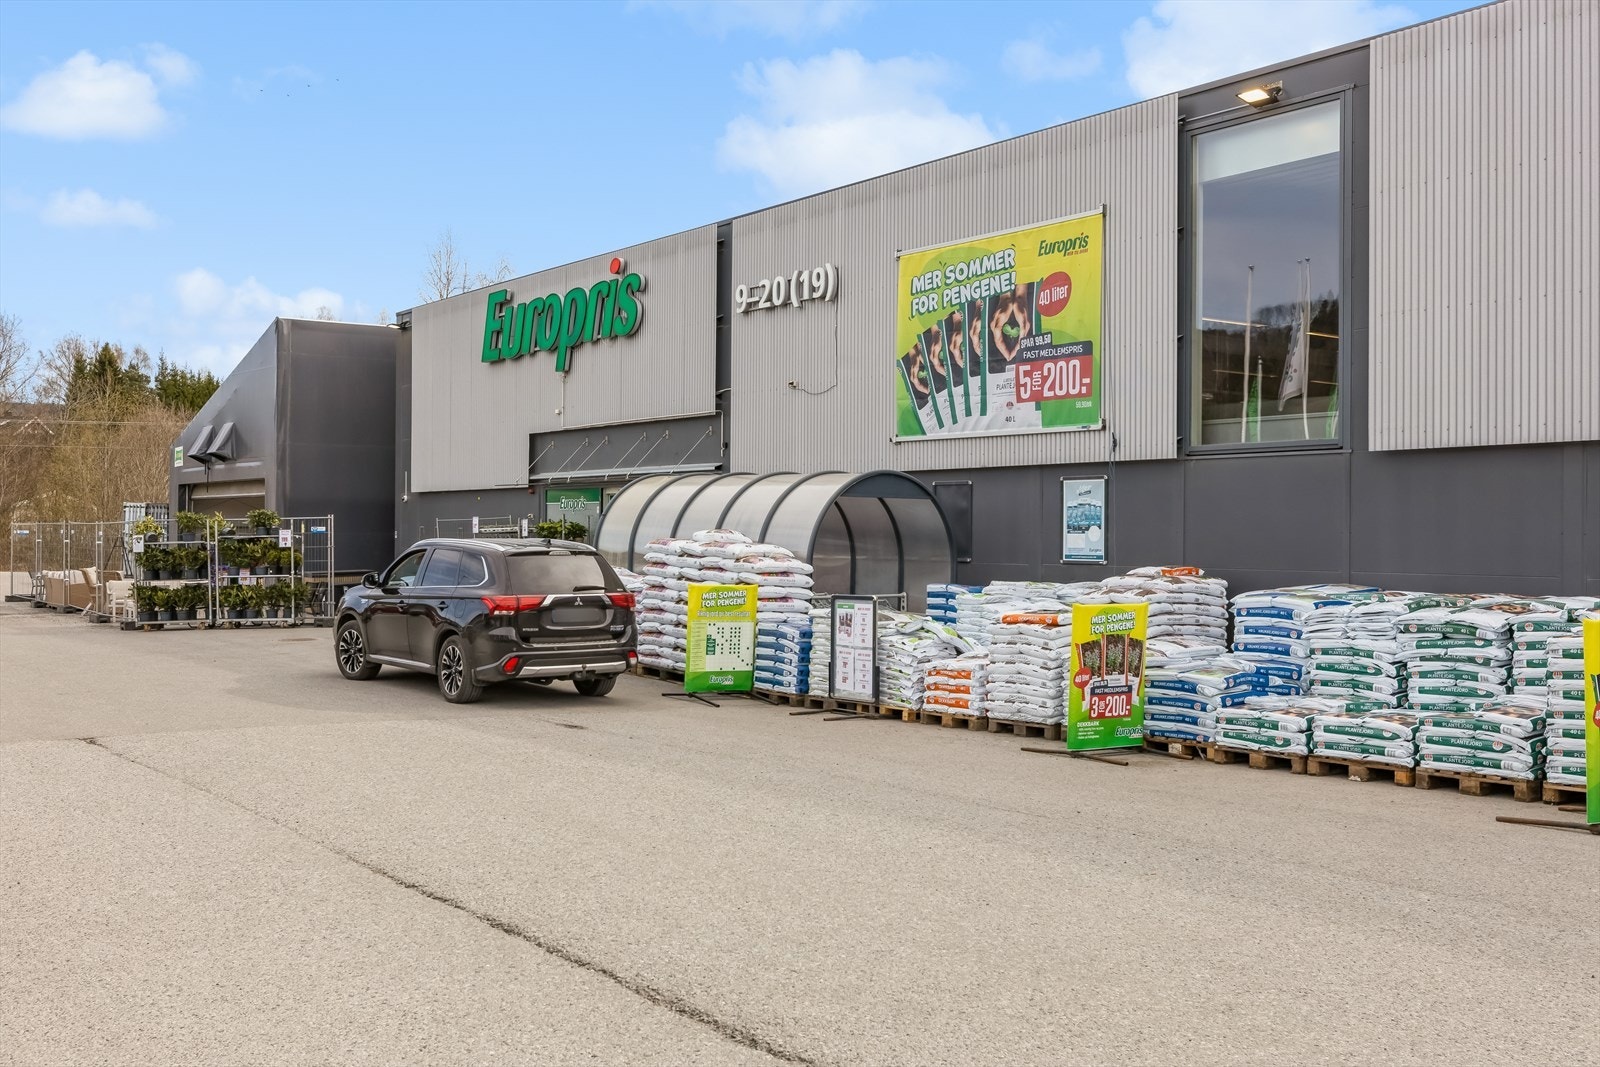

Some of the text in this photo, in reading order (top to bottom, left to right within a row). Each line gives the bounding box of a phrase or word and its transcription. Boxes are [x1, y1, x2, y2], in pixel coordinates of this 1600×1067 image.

[1038, 232, 1089, 256] Europris
[912, 248, 1016, 295] MER SOMMER
[790, 262, 837, 308] (19)
[912, 272, 1016, 318] FOR PENGENE!
[1039, 285, 1068, 306] 40 liter
[482, 258, 646, 372] Europris
[1020, 334, 1051, 349] SPAR 99,50
[1023, 345, 1083, 359] FAST MEDLEMSPRIS
[1018, 364, 1031, 399] 5
[1032, 370, 1042, 390] FOR
[560, 496, 586, 512] Europris
[717, 598, 747, 606] PENGENE!
[718, 590, 746, 598] SOMMER
[1091, 611, 1135, 624] MER SOMMER
[1091, 620, 1135, 634] FOR PENGENE!
[1091, 697, 1099, 717] 3
[1115, 725, 1143, 736] Europris
